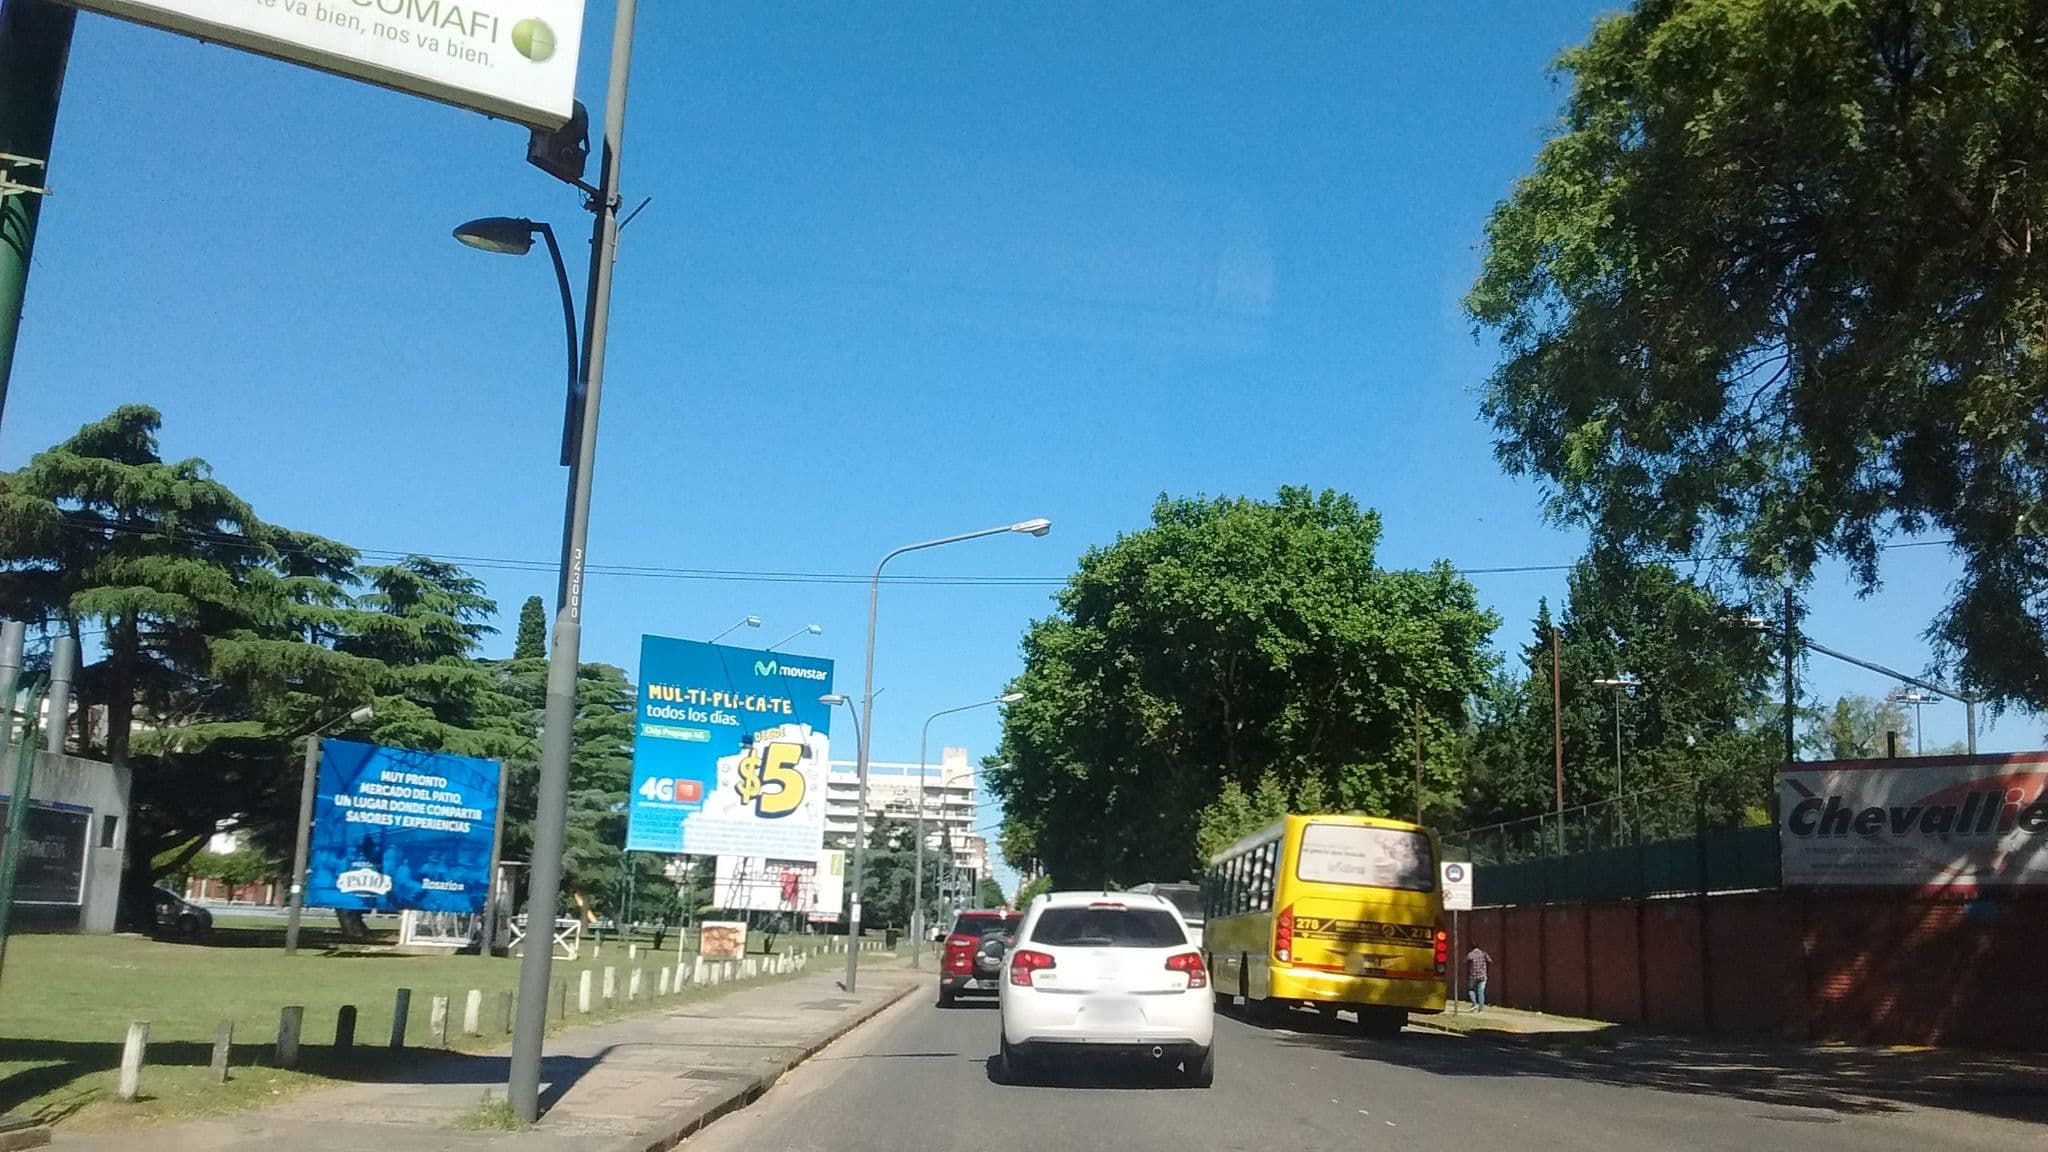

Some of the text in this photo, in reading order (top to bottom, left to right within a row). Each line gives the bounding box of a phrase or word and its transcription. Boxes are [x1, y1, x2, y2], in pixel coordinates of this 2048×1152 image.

[350, 0, 498, 43] OMAFI
[285, 1, 307, 16] va
[315, 7, 366, 34] bien,
[373, 22, 410, 43] nos
[417, 32, 439, 52] va
[449, 39, 495, 68] bien.
[779, 665, 828, 681] movistar
[648, 684, 793, 714] MUL-TI-PLI-CA-TE
[646, 704, 740, 726] todos los días.
[380, 770, 447, 788] MUY PRONTO
[639, 776, 674, 801] 4G
[736, 742, 806, 819] $5
[360, 782, 411, 798] MERCADO
[412, 788, 432, 801] DEL
[334, 794, 482, 820] UN LUGAR DONDE COMPARTIR
[346, 810, 470, 833] SABORES Y EXPERIENCIAS
[1296, 918, 1320, 930] 278
